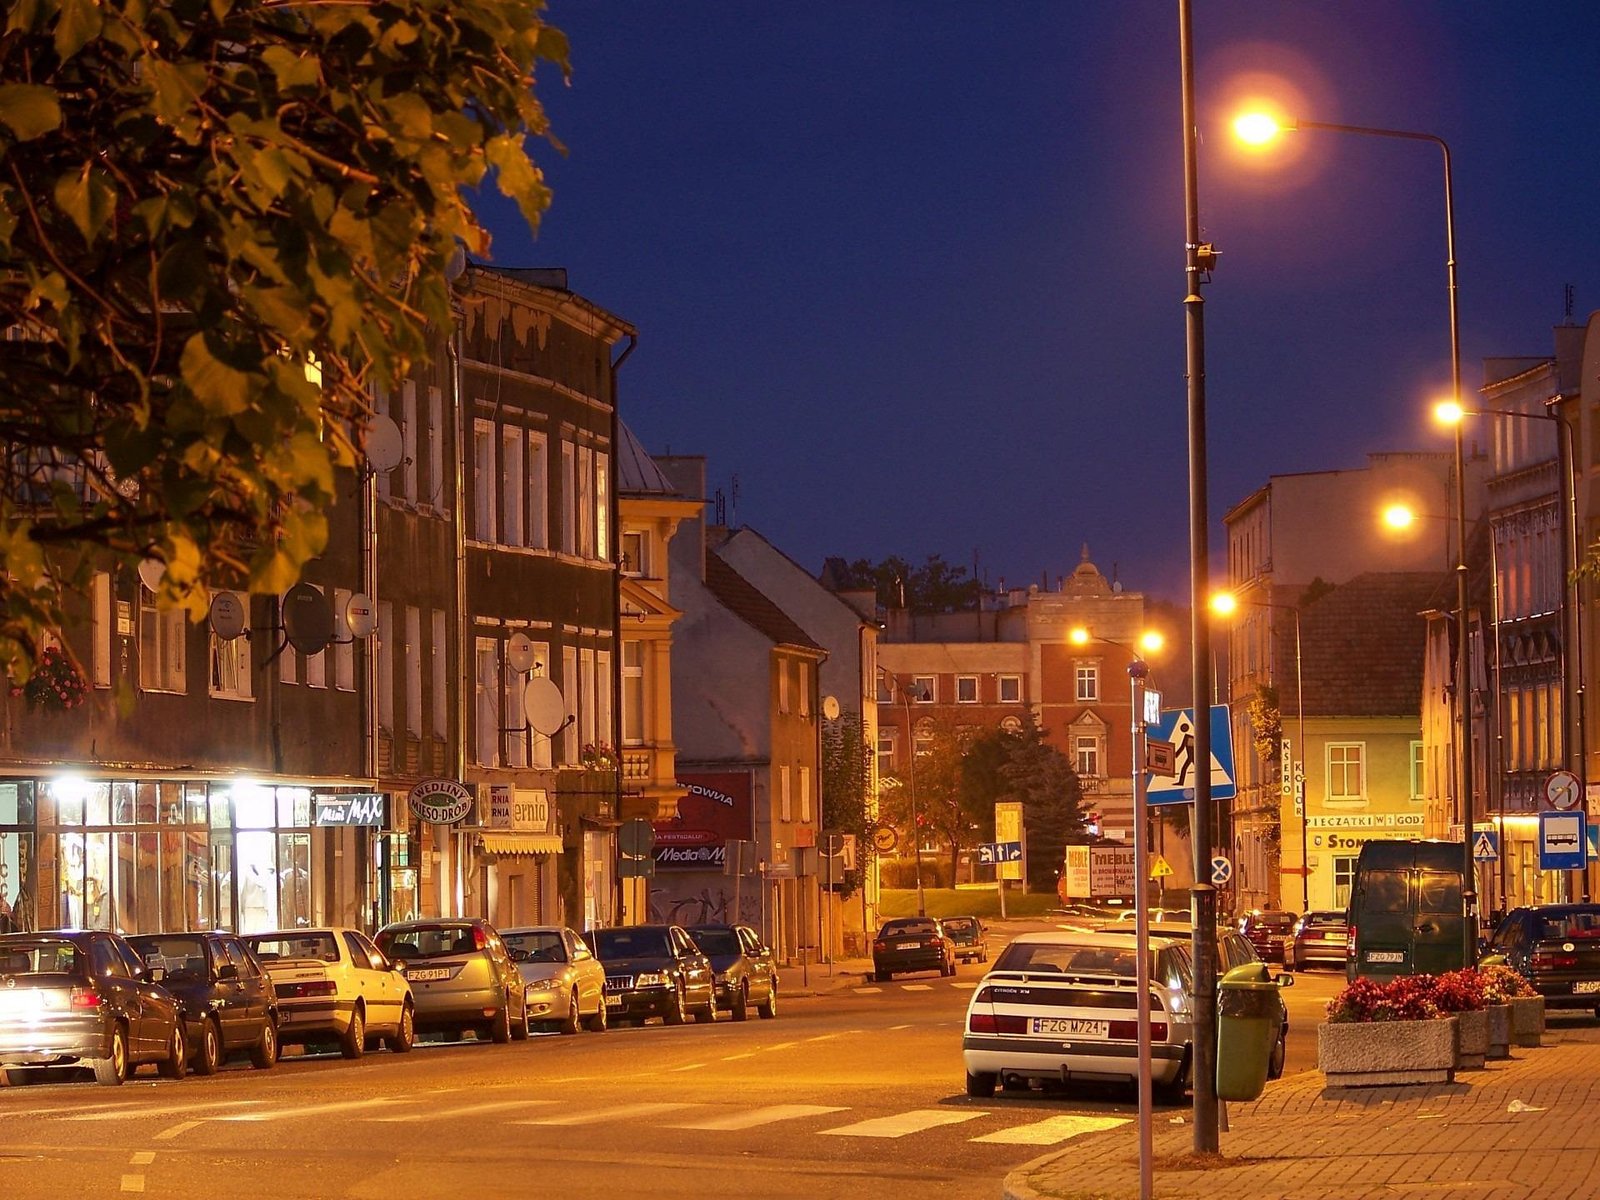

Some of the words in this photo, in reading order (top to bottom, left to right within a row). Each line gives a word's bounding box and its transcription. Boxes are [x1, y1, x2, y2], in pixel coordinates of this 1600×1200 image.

[1283, 741, 1291, 793] KSERO
[1295, 763, 1303, 815] KOLOR
[346, 797, 383, 824] MAX
[657, 847, 699, 861] Media
[409, 971, 426, 980] FZG
[428, 969, 448, 979] 91PT
[1040, 1020, 1067, 1033] FZG
[1071, 1020, 1099, 1034] M724
